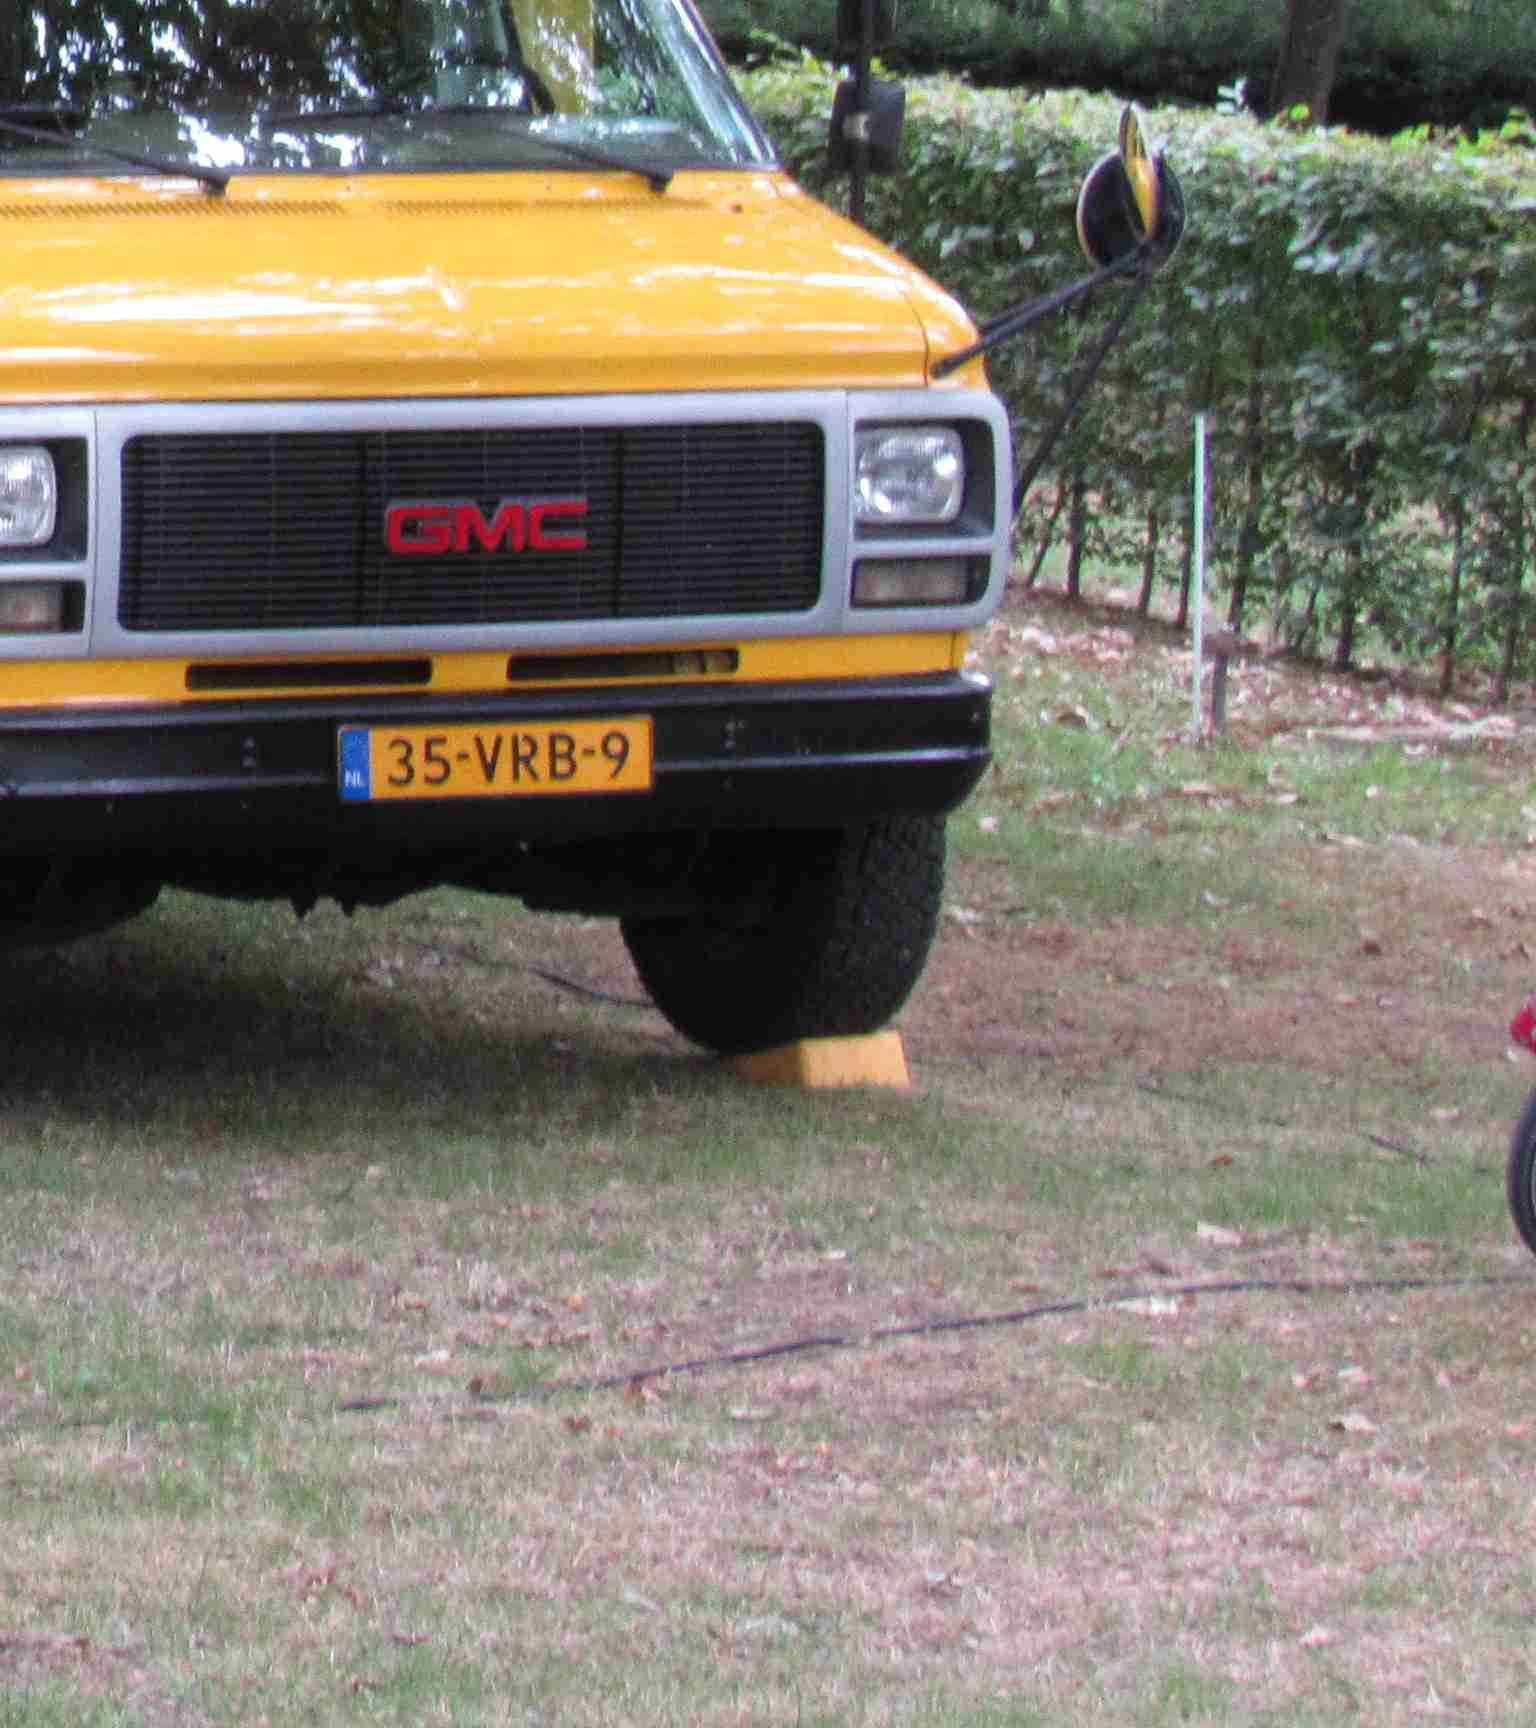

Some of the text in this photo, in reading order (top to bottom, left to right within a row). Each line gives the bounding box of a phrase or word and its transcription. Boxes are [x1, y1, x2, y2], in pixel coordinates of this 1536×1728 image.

[385, 496, 588, 555] GMC
[344, 768, 365, 787] NL
[387, 731, 630, 787] 35-VRB-9
